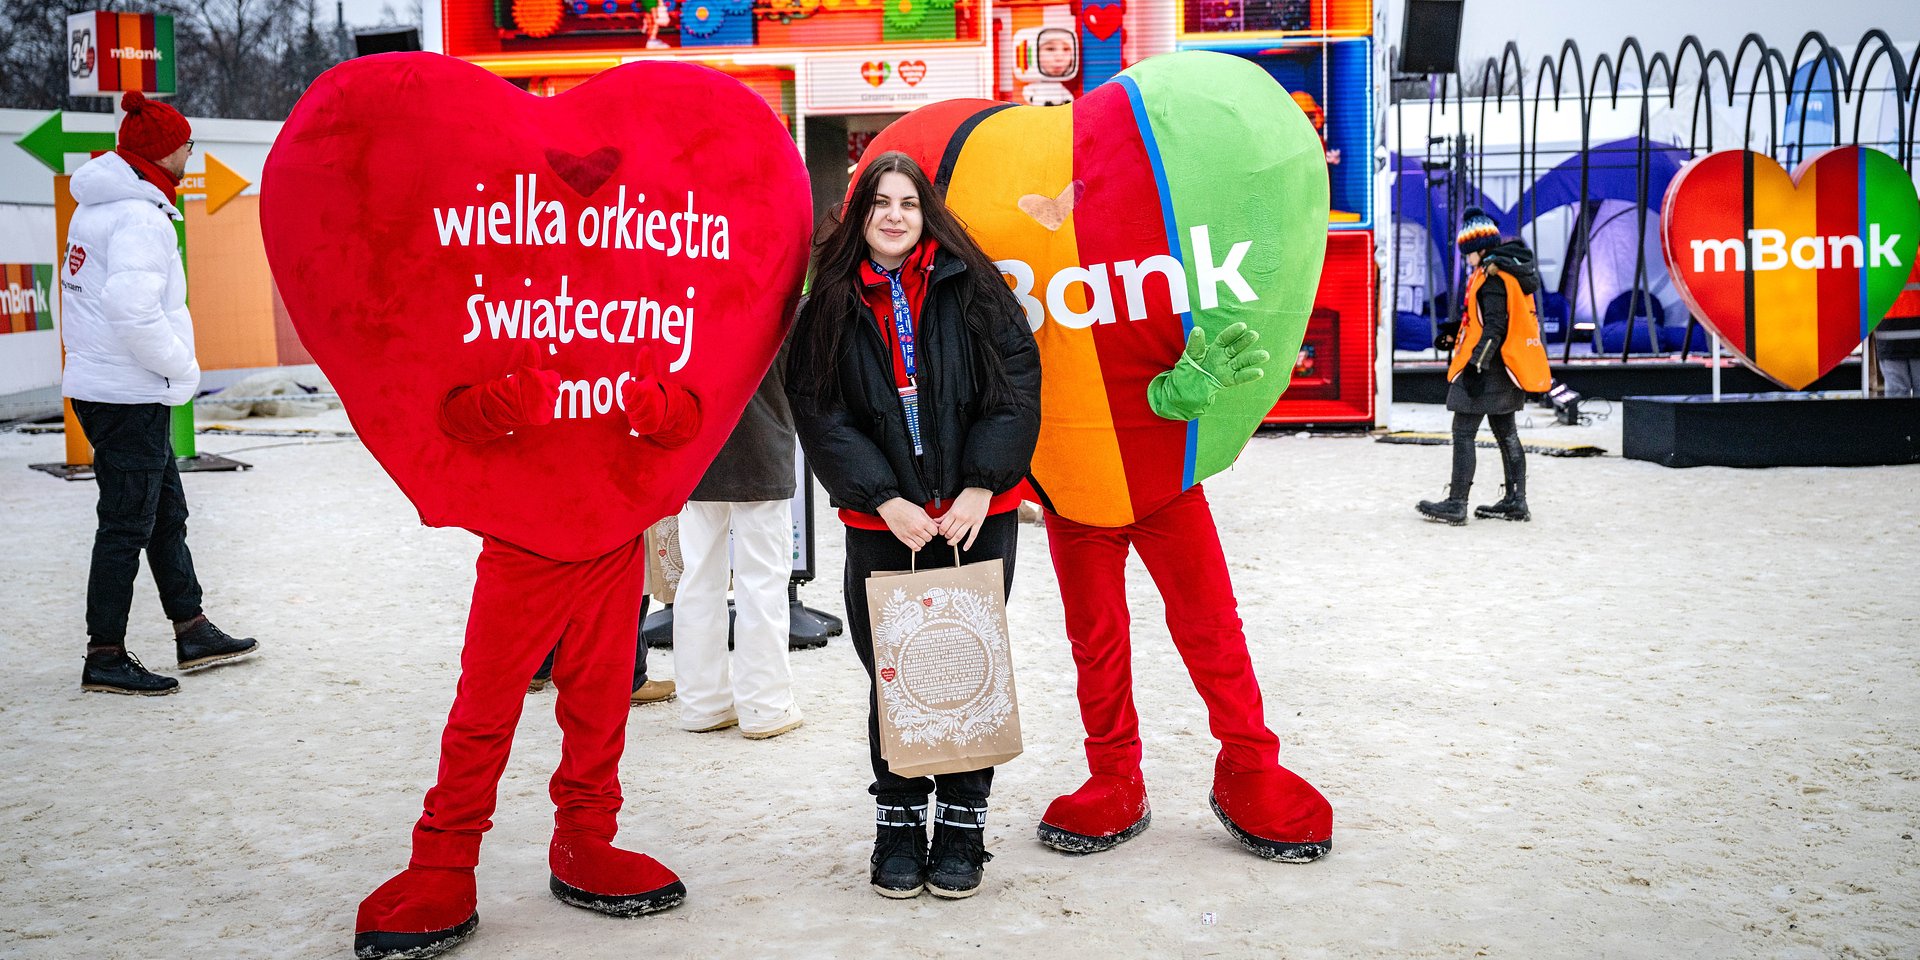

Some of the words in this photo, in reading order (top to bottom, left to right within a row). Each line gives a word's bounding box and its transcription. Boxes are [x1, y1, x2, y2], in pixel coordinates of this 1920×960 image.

[110, 47, 162, 61] mBank
[433, 174, 566, 246] wielka
[578, 185, 730, 260] orkiestra
[1690, 223, 1902, 273] mBank
[991, 224, 1259, 334] Bank
[463, 274, 694, 373] świątecznej
